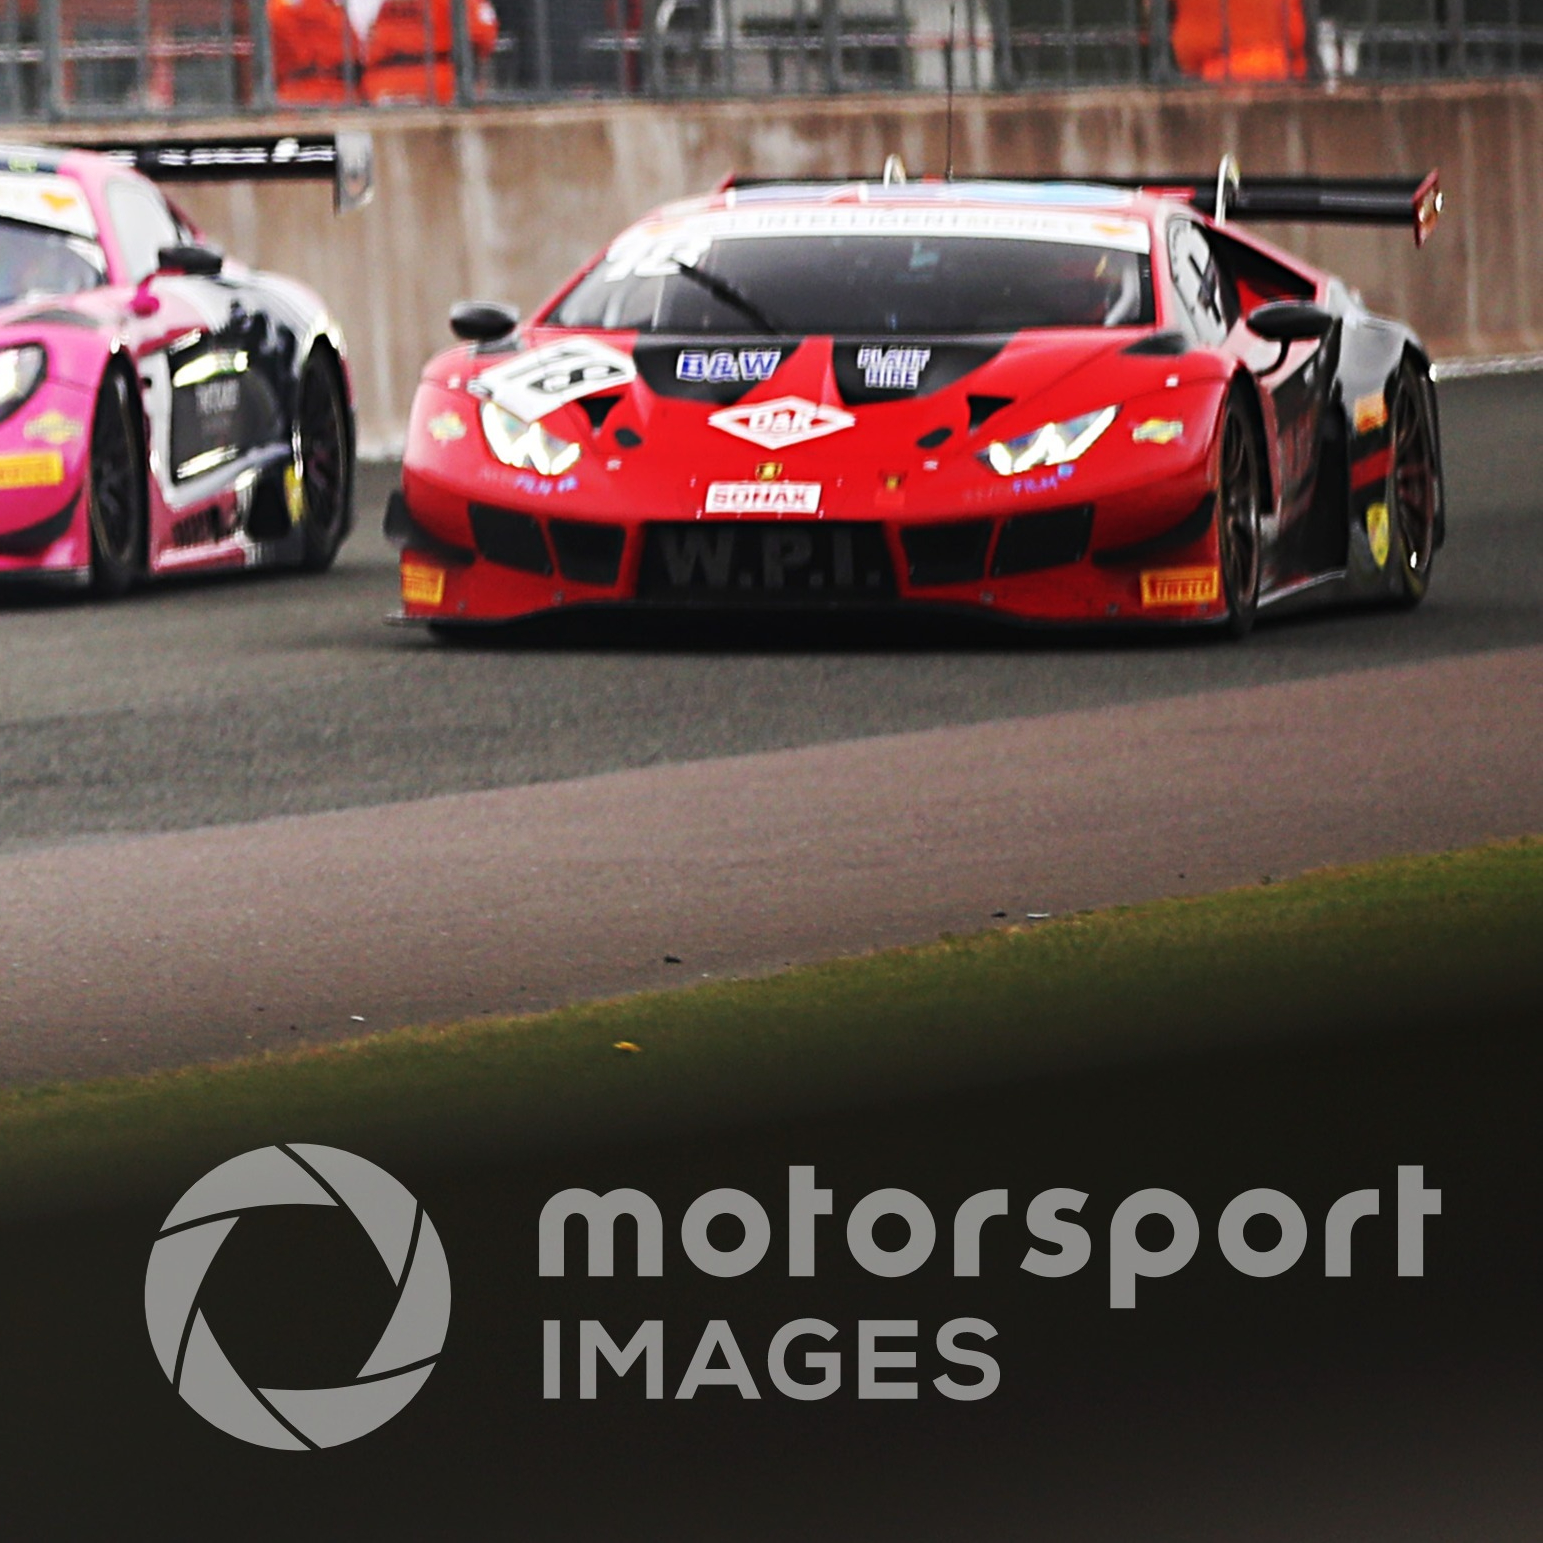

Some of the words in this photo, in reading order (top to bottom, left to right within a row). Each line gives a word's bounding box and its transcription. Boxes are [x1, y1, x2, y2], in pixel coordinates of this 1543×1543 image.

[676, 347, 781, 383] B&W
[712, 488, 809, 506] SONAX
[659, 527, 883, 589] W.P.I.
